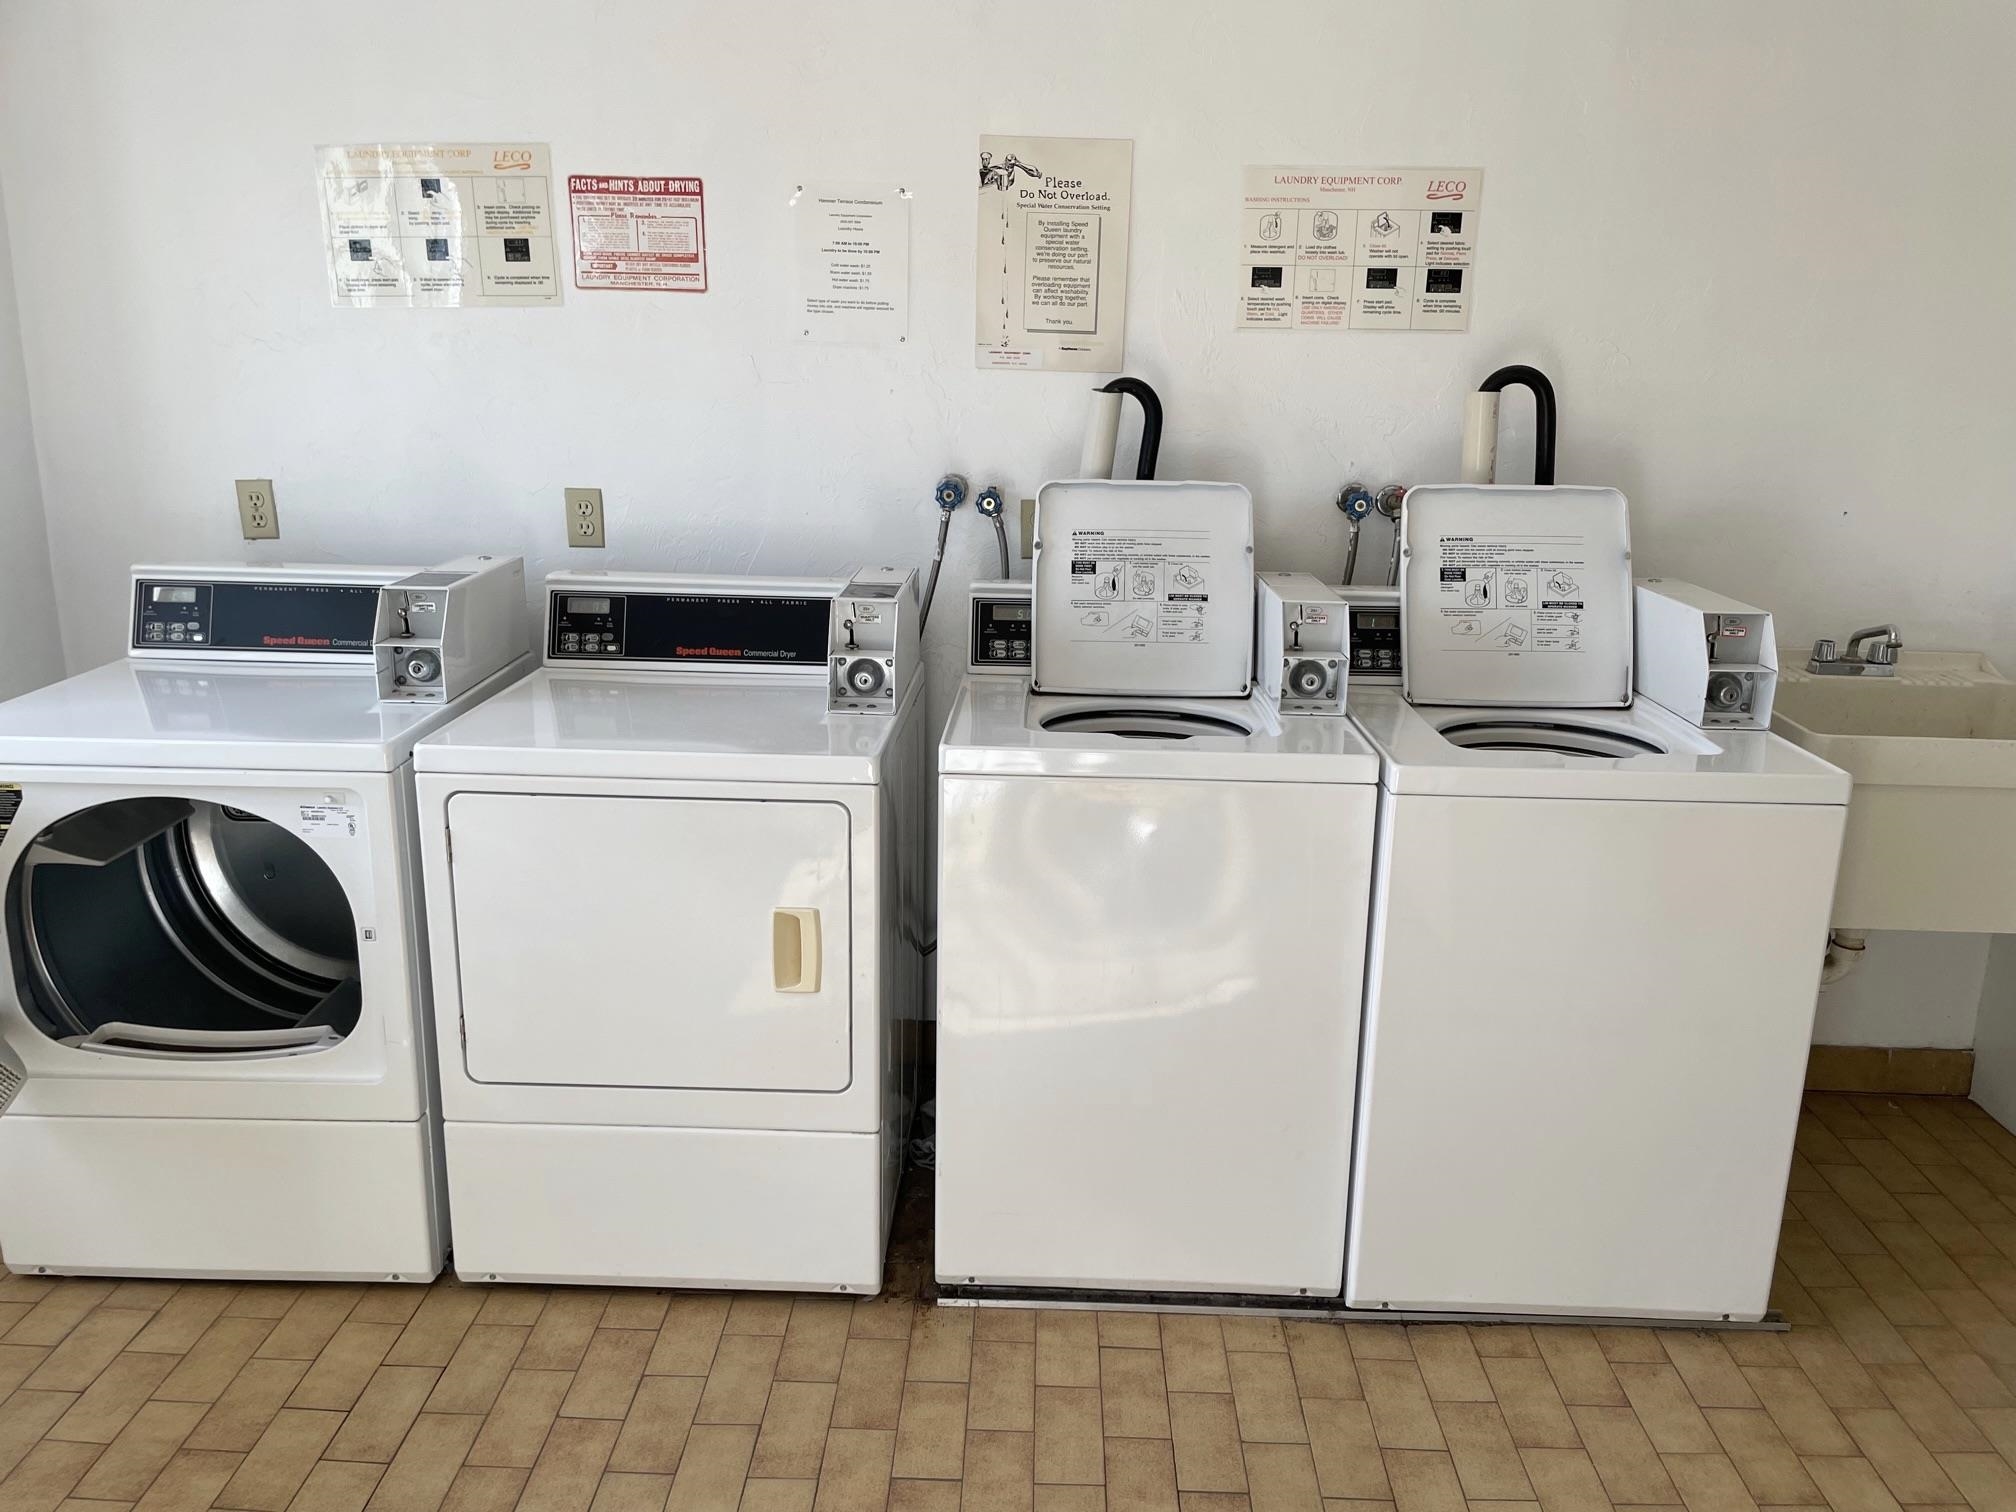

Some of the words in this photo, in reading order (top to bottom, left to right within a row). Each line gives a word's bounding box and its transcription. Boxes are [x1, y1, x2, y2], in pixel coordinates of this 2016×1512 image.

[494, 150, 532, 162] LECO
[570, 178, 598, 191] FACTS
[608, 179, 635, 192] HINTS
[638, 180, 665, 193] ABOUT
[668, 180, 700, 193] DRYING
[1045, 176, 1082, 188] Please
[1274, 175, 1320, 185] LAUNDRY
[1321, 176, 1376, 186] EQUIPMENT
[1427, 180, 1467, 193] LECO
[1020, 190, 1034, 198] Do
[1038, 190, 1058, 200] Not
[1060, 191, 1111, 201] Overload.
[1016, 202, 1036, 210] Special
[263, 636, 296, 648] Speed
[297, 636, 330, 646] Queen
[332, 638, 368, 647] Commercial
[676, 646, 708, 658] Speed
[708, 647, 742, 656] Queen
[743, 648, 778, 658] Commercial
[780, 650, 797, 660] Dryer
